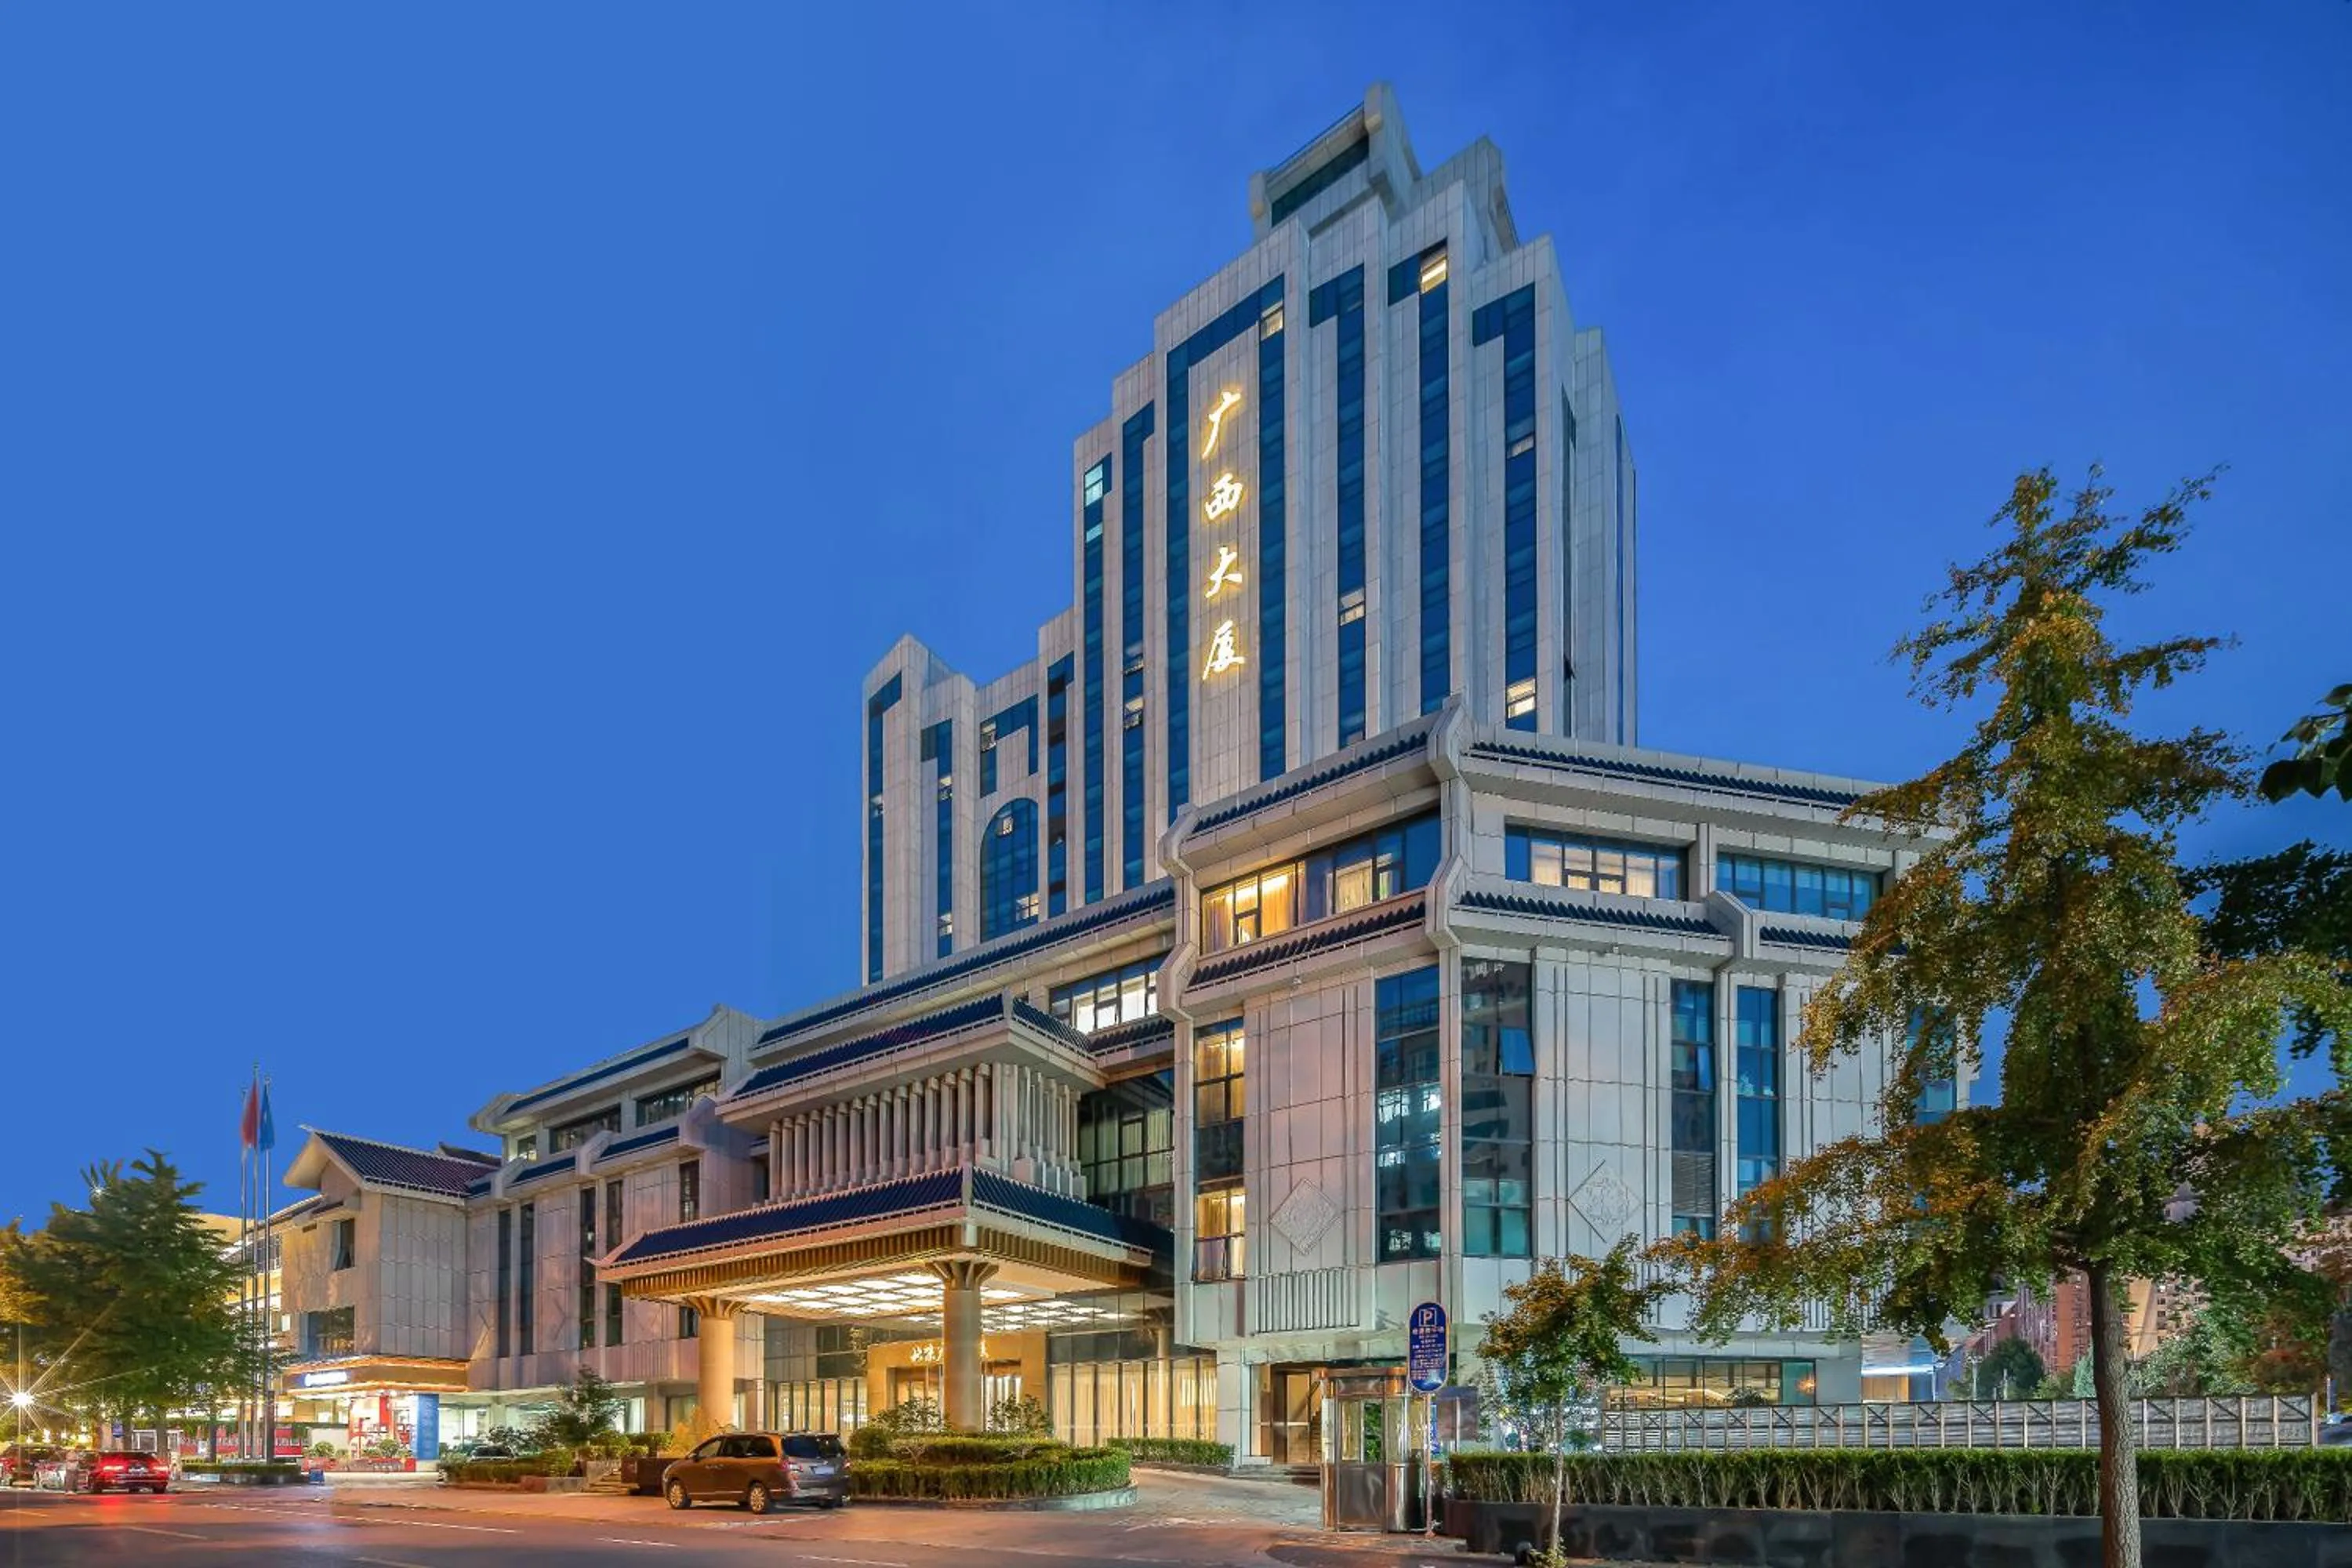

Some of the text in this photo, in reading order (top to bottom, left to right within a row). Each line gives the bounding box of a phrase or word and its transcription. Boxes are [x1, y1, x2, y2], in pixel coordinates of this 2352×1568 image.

[1201, 390, 1247, 681] 广西大厦
[1423, 1310, 1433, 1326] P
